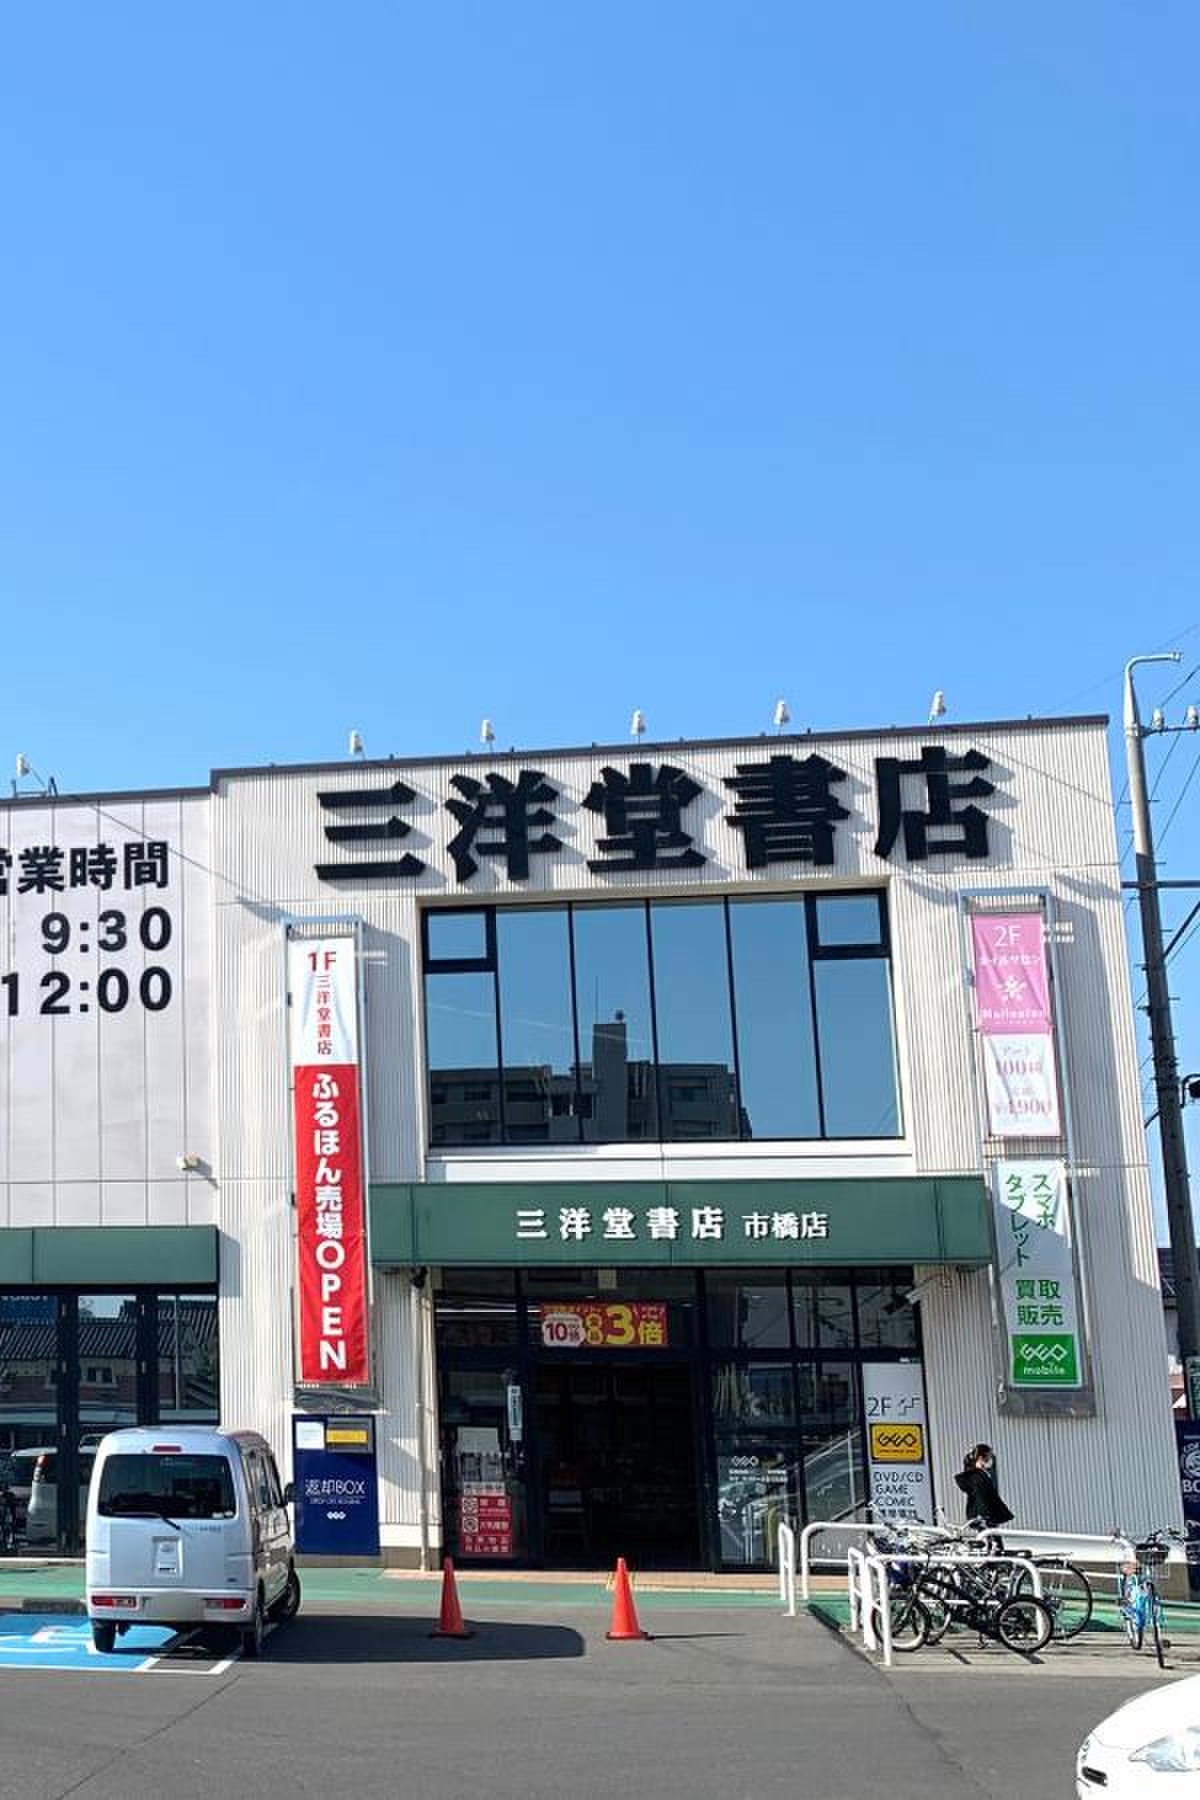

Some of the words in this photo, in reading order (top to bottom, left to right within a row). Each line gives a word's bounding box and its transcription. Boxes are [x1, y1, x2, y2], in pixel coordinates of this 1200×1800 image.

[315, 745, 998, 883] 三洋堂書店
[41, 906, 172, 955] 9:30
[994, 926, 1021, 947] 2F
[307, 951, 337, 972] 1F
[1, 966, 172, 1016] 12:00
[316, 975, 333, 1056] 三洋堂書店
[1033, 1174, 1055, 1231] スマホ
[312, 1073, 346, 1370] ふるほん売場OPEN
[516, 1207, 724, 1240] 三洋堂書店
[742, 1212, 828, 1239] 市橋店
[1006, 1174, 1030, 1267] タブレット
[1016, 1280, 1060, 1299] 買取
[1018, 1305, 1063, 1325] 販売
[1020, 1343, 1068, 1361] GEO
[1023, 1362, 1065, 1376] mobile
[867, 1397, 892, 1417] 2F
[873, 1471, 925, 1484] DVD/CD
[875, 1484, 909, 1495] GAME
